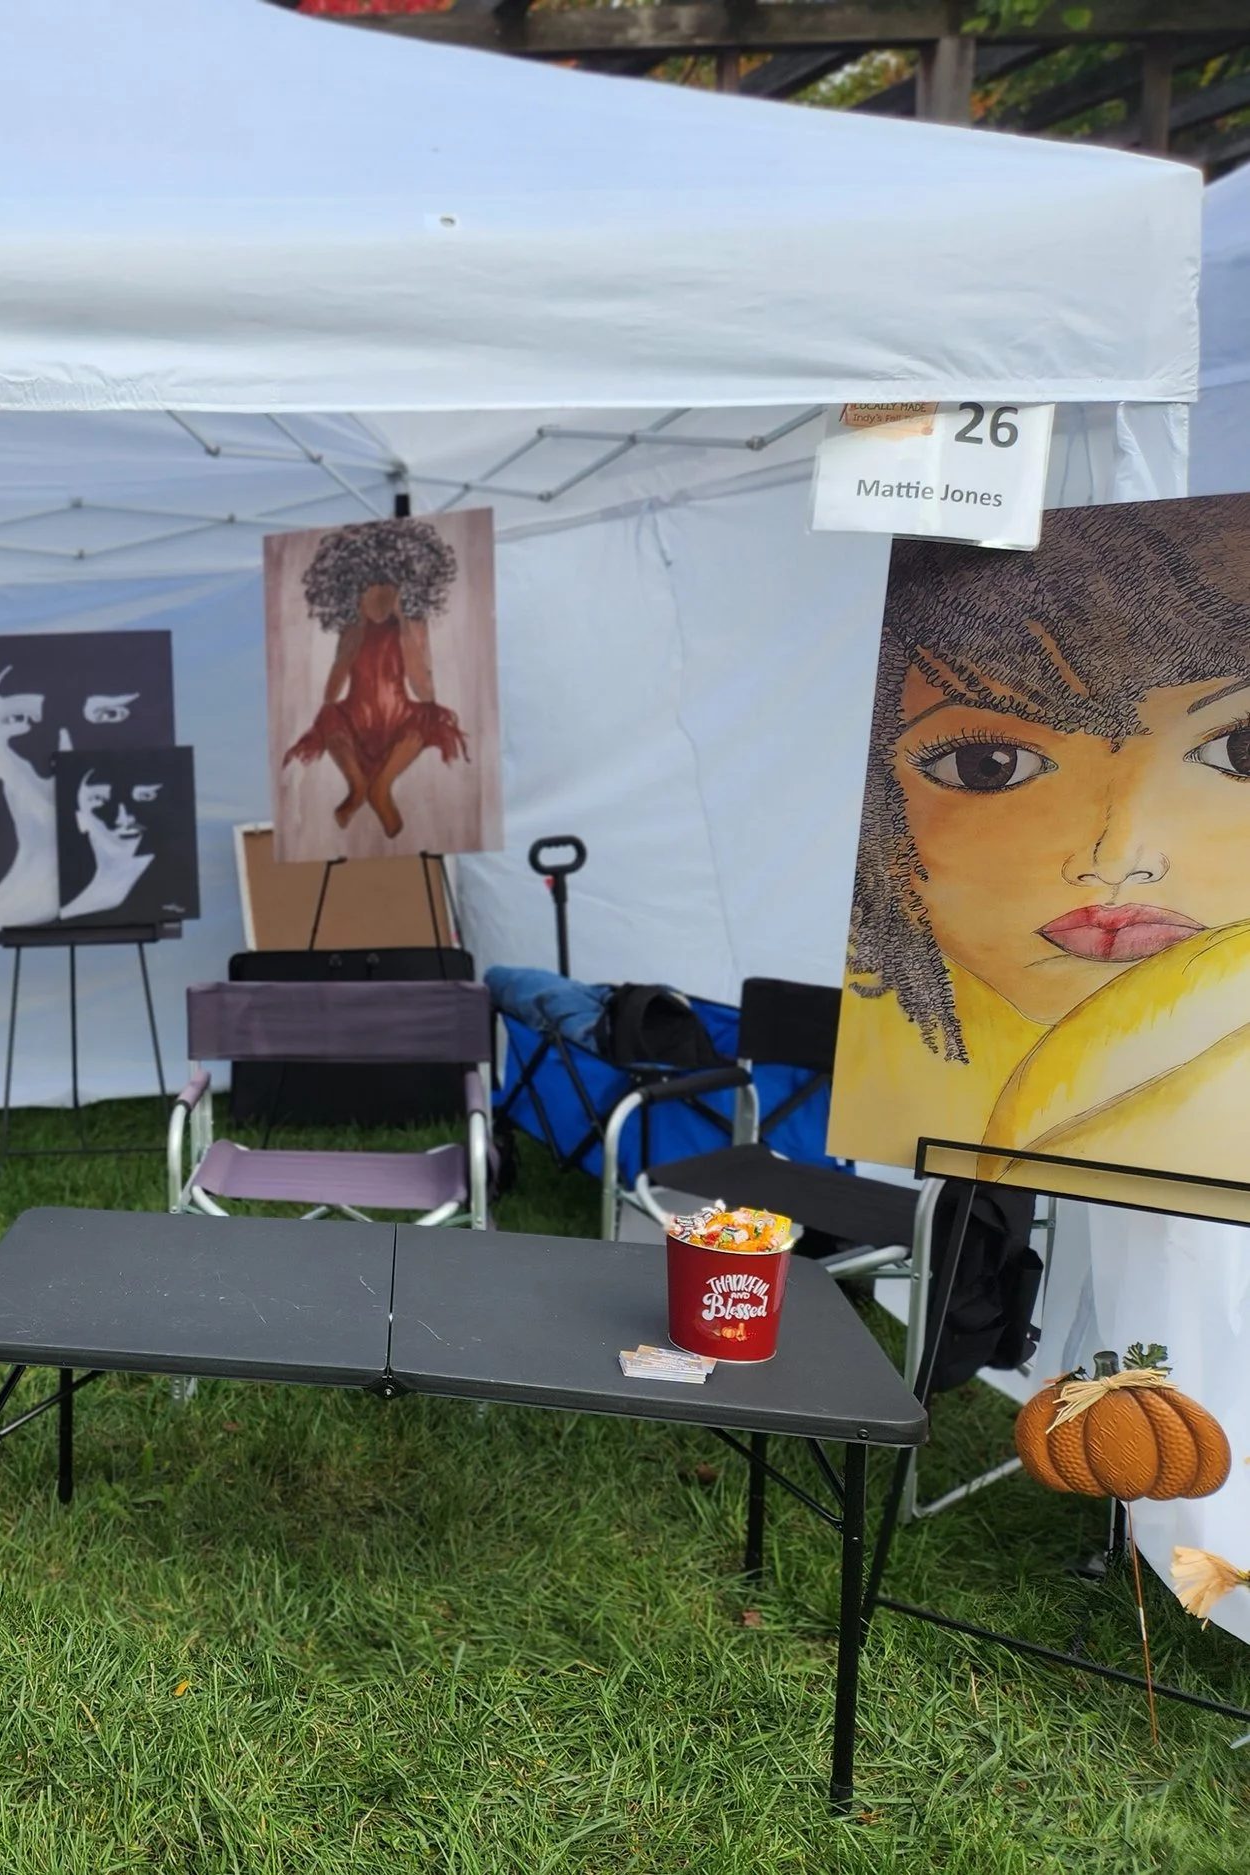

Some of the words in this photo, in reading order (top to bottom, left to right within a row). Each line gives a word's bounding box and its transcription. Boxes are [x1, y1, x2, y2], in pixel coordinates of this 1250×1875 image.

[853, 413, 882, 424] Indy's
[954, 401, 1019, 448] 26
[856, 479, 934, 500] Mattie
[940, 484, 1003, 507] Jones
[705, 1273, 771, 1300] THANKFUL
[701, 1293, 768, 1321] Blessed
